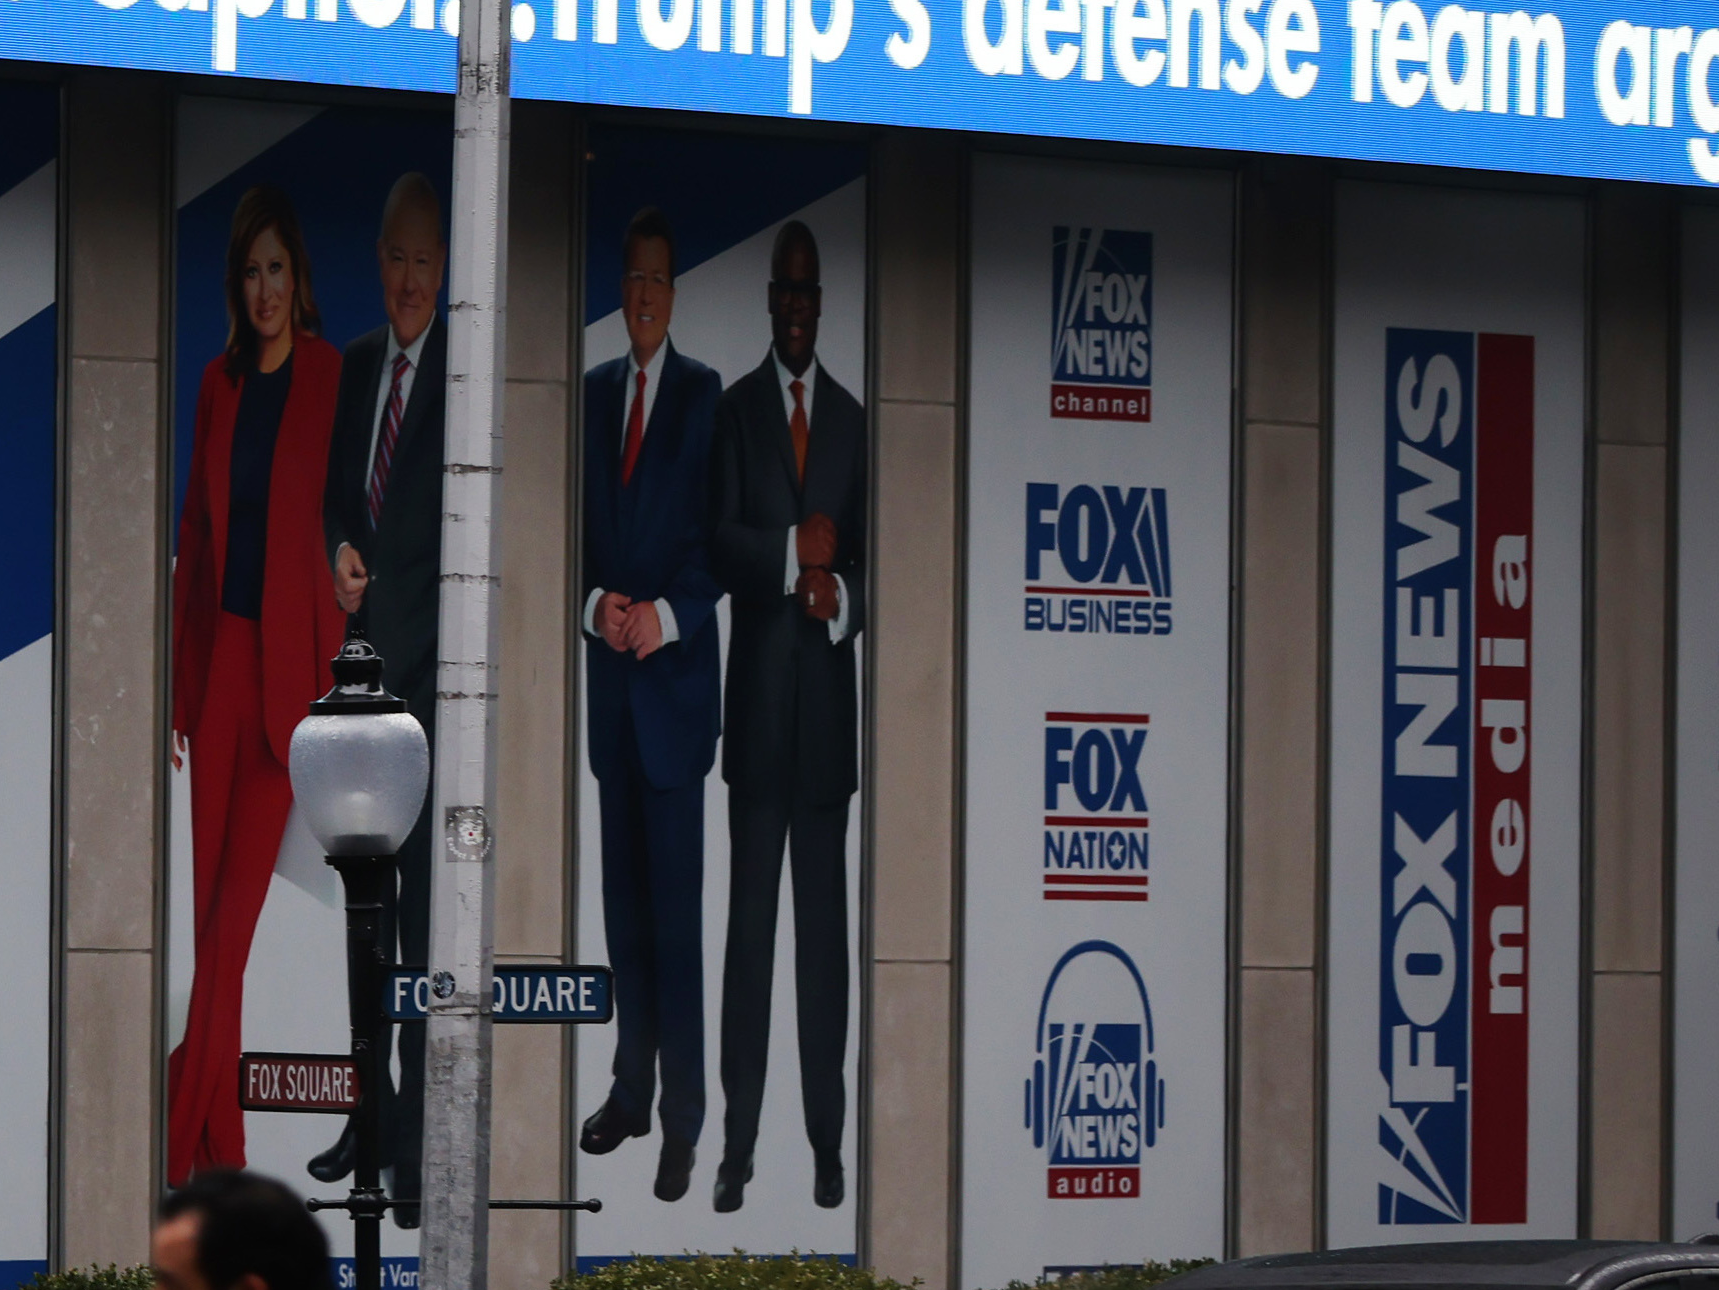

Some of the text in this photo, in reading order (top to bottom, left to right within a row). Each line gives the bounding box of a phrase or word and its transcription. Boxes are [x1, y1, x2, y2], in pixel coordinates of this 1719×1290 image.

[1085, 272, 1148, 325] FOX
[1066, 327, 1149, 378] NEWS
[1054, 393, 1146, 415] channel
[1026, 483, 1147, 585] FOX
[1025, 597, 1172, 635] BUSINESS
[1390, 354, 1462, 1103] FOX NEWS
[1044, 727, 1148, 812] FOX
[1480, 534, 1527, 1014] media
[1044, 830, 1148, 870] NATION
[394, 976, 597, 1012] FO QUARE
[248, 1064, 354, 1102] FOX SQUARE
[1079, 1062, 1137, 1109] FOX
[1061, 1114, 1138, 1158] NEWS
[1056, 1172, 1132, 1194] audio
